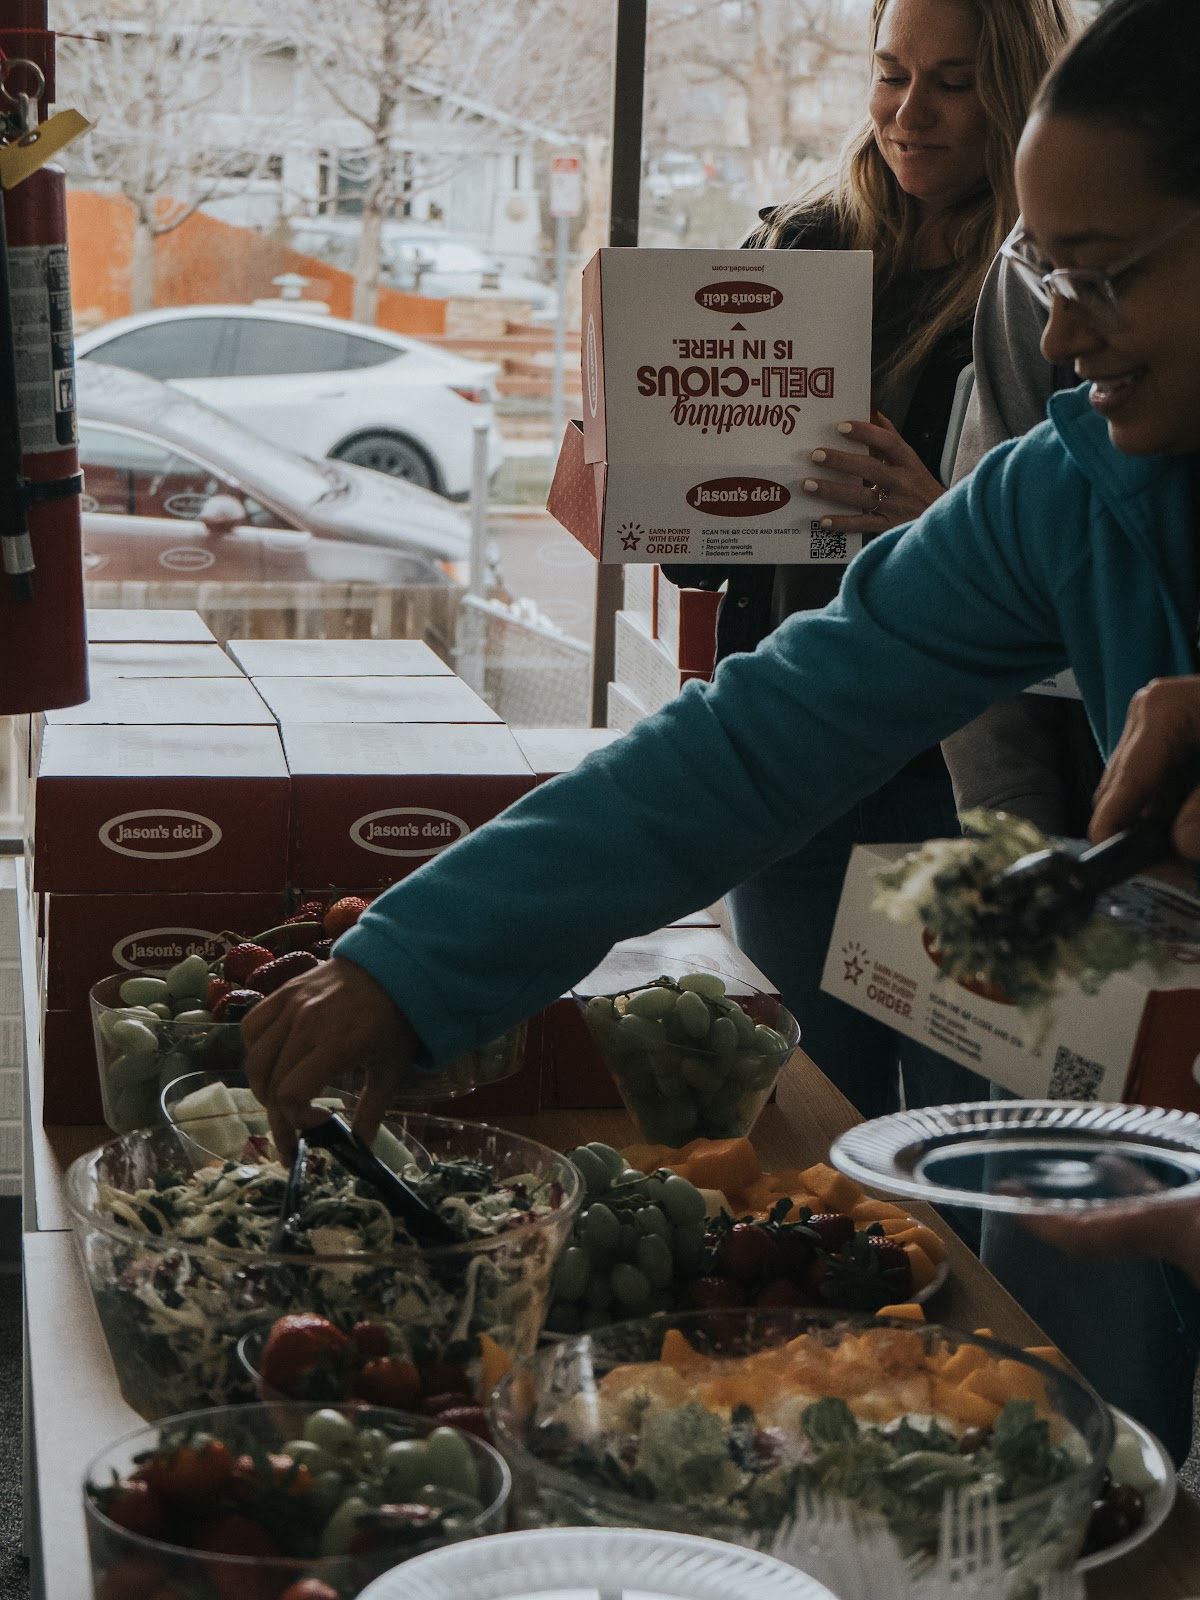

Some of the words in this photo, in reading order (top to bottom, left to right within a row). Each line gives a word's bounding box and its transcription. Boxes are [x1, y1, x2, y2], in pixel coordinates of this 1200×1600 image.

[711, 265, 765, 273] jasonsdeli.com
[703, 292, 729, 307] deli
[731, 290, 777, 306] Jason's
[672, 339, 735, 360] HERE.
[742, 340, 766, 360] IN
[773, 340, 793, 360] IS
[636, 365, 835, 399] DELI-CIOUS
[670, 394, 801, 436] Something
[694, 486, 748, 506] Jason's
[750, 486, 781, 502] deli
[646, 543, 691, 554] ORDER.
[116, 825, 170, 843] Jason's
[172, 825, 203, 839] deli
[366, 822, 419, 840] Jason's
[421, 822, 452, 837] deli
[129, 943, 183, 961] Jason's
